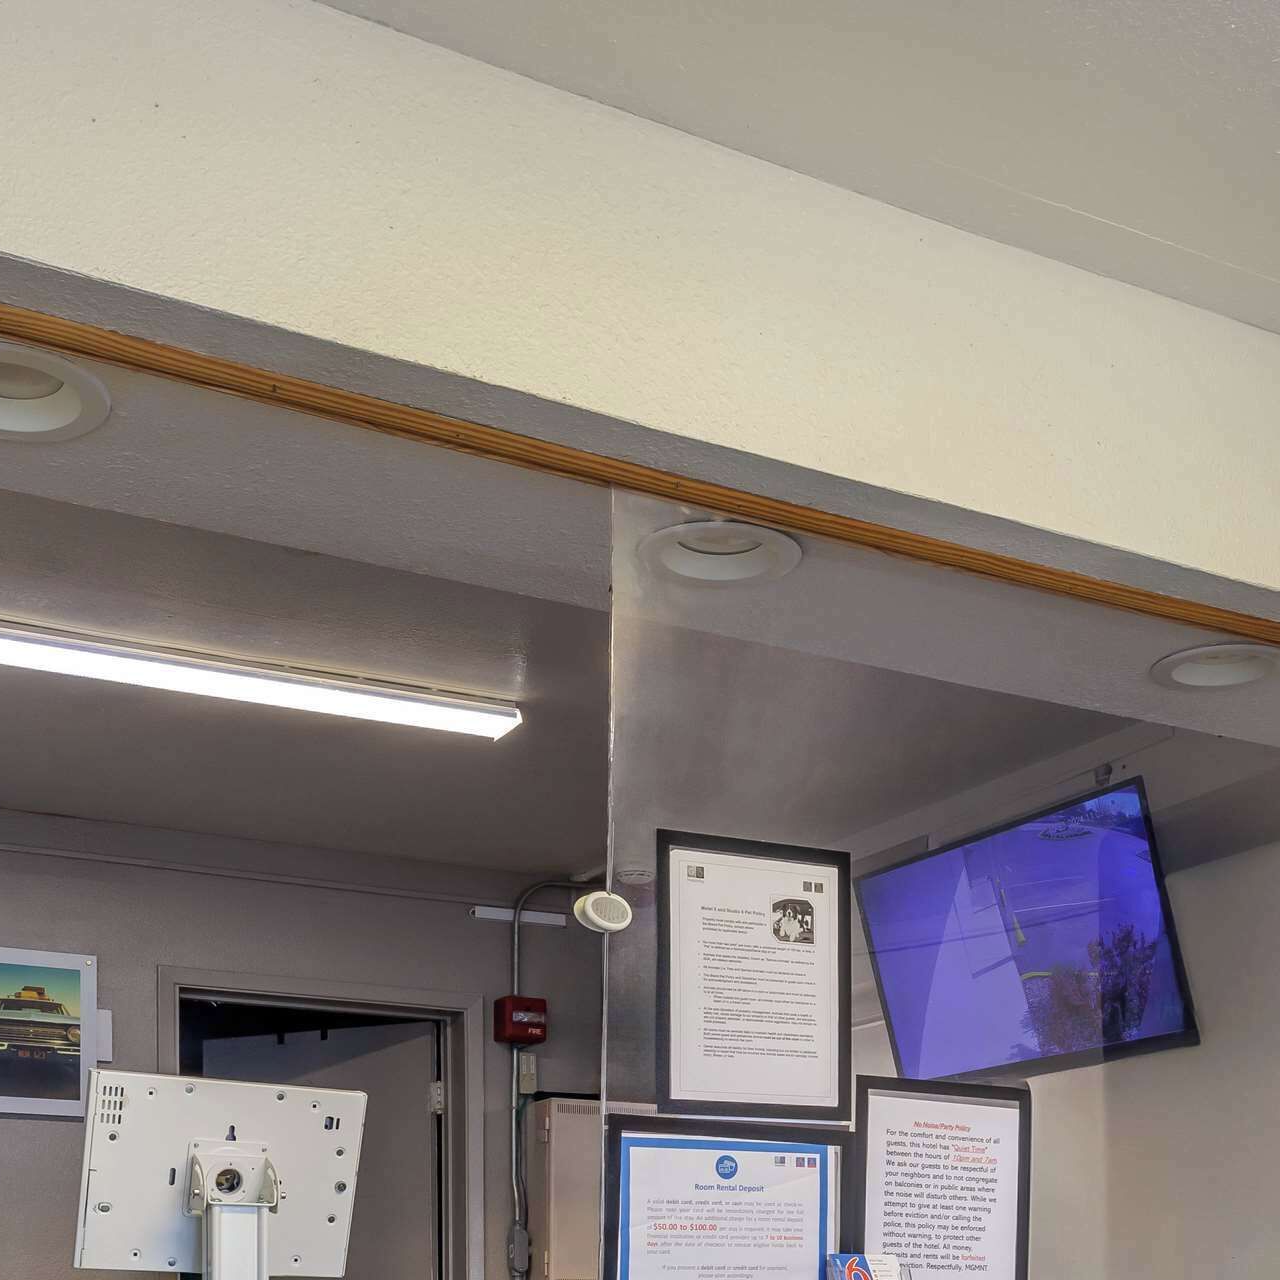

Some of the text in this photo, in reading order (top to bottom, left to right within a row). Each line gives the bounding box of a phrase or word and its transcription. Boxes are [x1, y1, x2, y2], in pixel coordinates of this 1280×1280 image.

[910, 1131, 933, 1139] comfort
[948, 1135, 984, 1143] convenience
[960, 1165, 988, 1173] respectful
[901, 1171, 930, 1179] neighbors
[965, 1176, 997, 1184] congregate
[739, 1185, 764, 1193] Deposit
[941, 1183, 958, 1191] public
[918, 1202, 930, 1210] give
[968, 1206, 991, 1214] warning
[952, 1214, 970, 1222] calling
[690, 1224, 717, 1232] $100.00
[918, 1223, 935, 1231] policy
